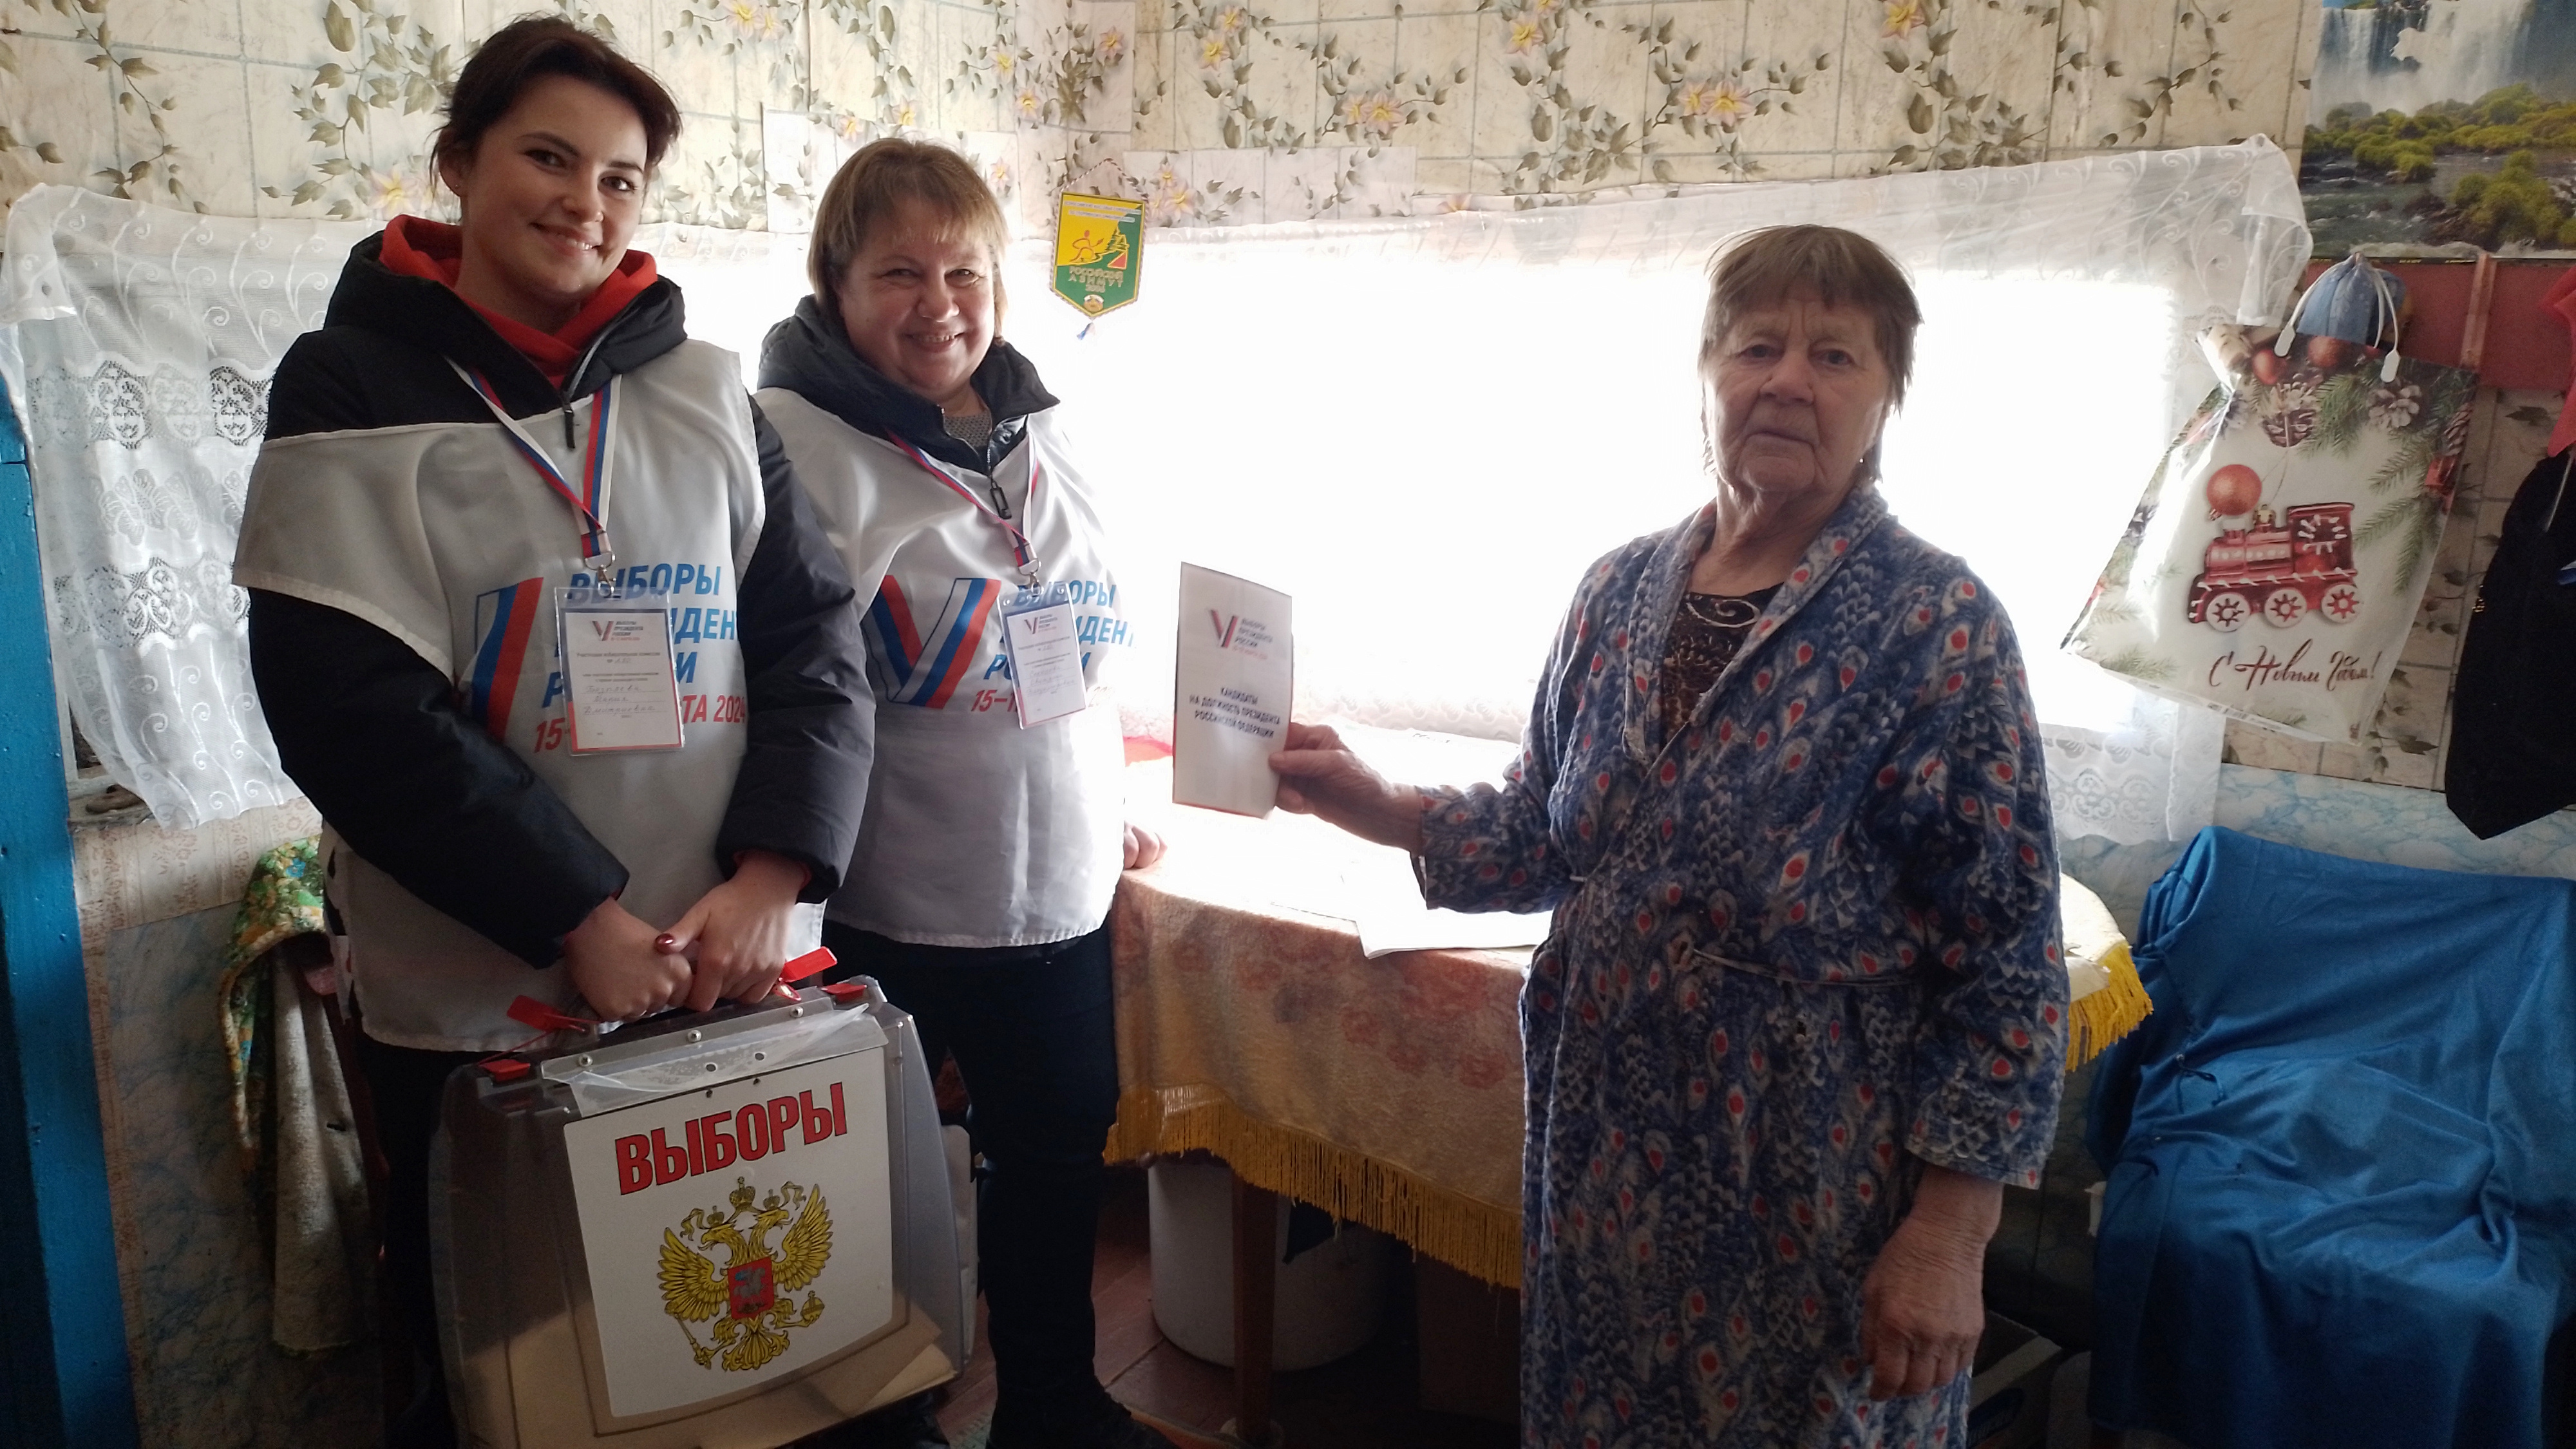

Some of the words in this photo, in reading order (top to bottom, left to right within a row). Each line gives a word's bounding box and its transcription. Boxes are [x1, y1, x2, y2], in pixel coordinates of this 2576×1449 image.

[566, 563, 721, 605] ВЫБОРЫ
[2209, 650, 2235, 687] С
[2234, 638, 2320, 691] Новым
[1189, 694, 1199, 704] НА
[1241, 707, 1280, 724] ПРЕЗИДЕНТА
[1220, 687, 1258, 706] КАНДИДАТЫ
[615, 1082, 847, 1195] ВЫБОРЫ
